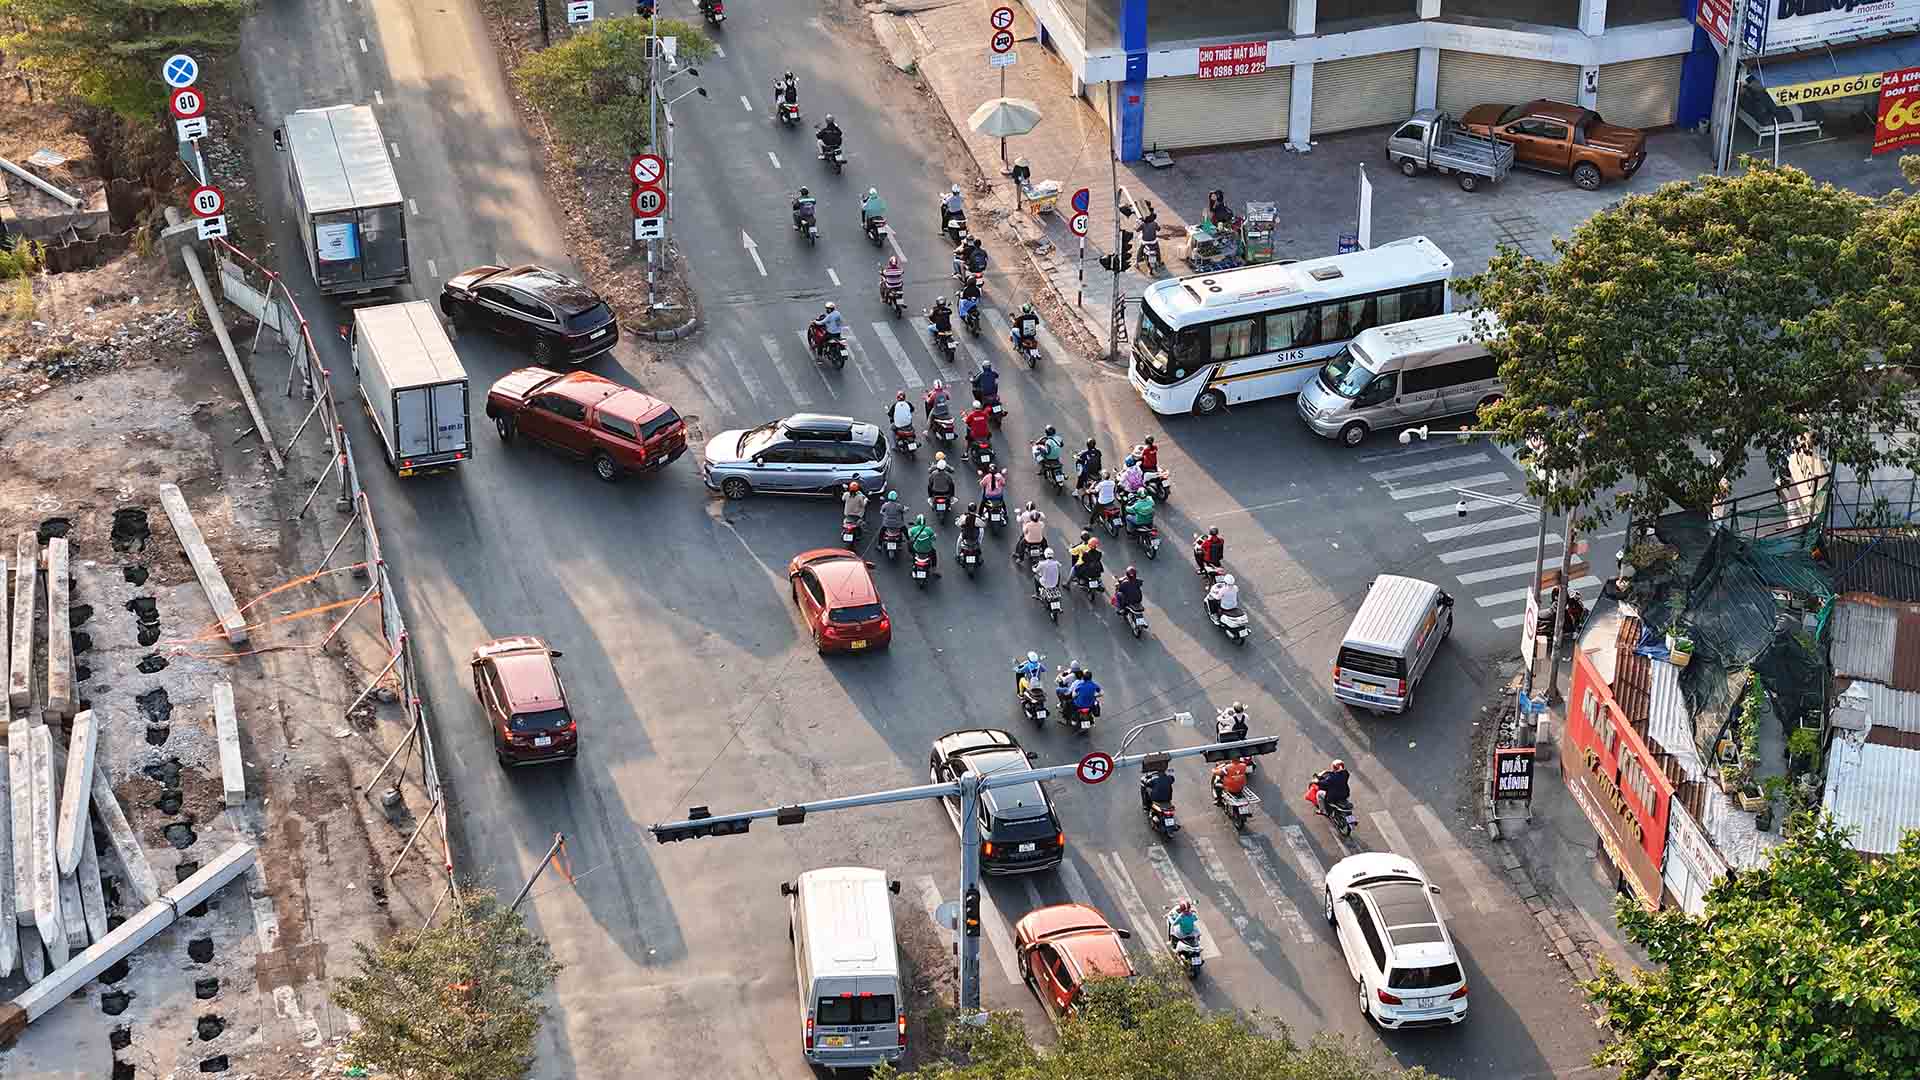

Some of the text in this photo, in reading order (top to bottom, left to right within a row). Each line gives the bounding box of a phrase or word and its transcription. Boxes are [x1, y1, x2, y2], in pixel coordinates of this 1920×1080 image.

[1857, 1, 1895, 14] moments
[1200, 42, 1267, 62] CHO THUÊ MẶT BẰNG
[1200, 61, 1265, 78] LH: 0986 992 225
[1803, 84, 1840, 99] DRAP
[1844, 75, 1868, 93] GỐI
[179, 95, 195, 110] 80
[199, 194, 215, 209] 60
[641, 194, 656, 209] 60
[1277, 350, 1304, 363] SIKS
[1582, 688, 1616, 753] MẮT
[1618, 741, 1657, 816] KÍNH
[1502, 754, 1529, 773] MẮT
[1499, 774, 1529, 791] KÍNH
